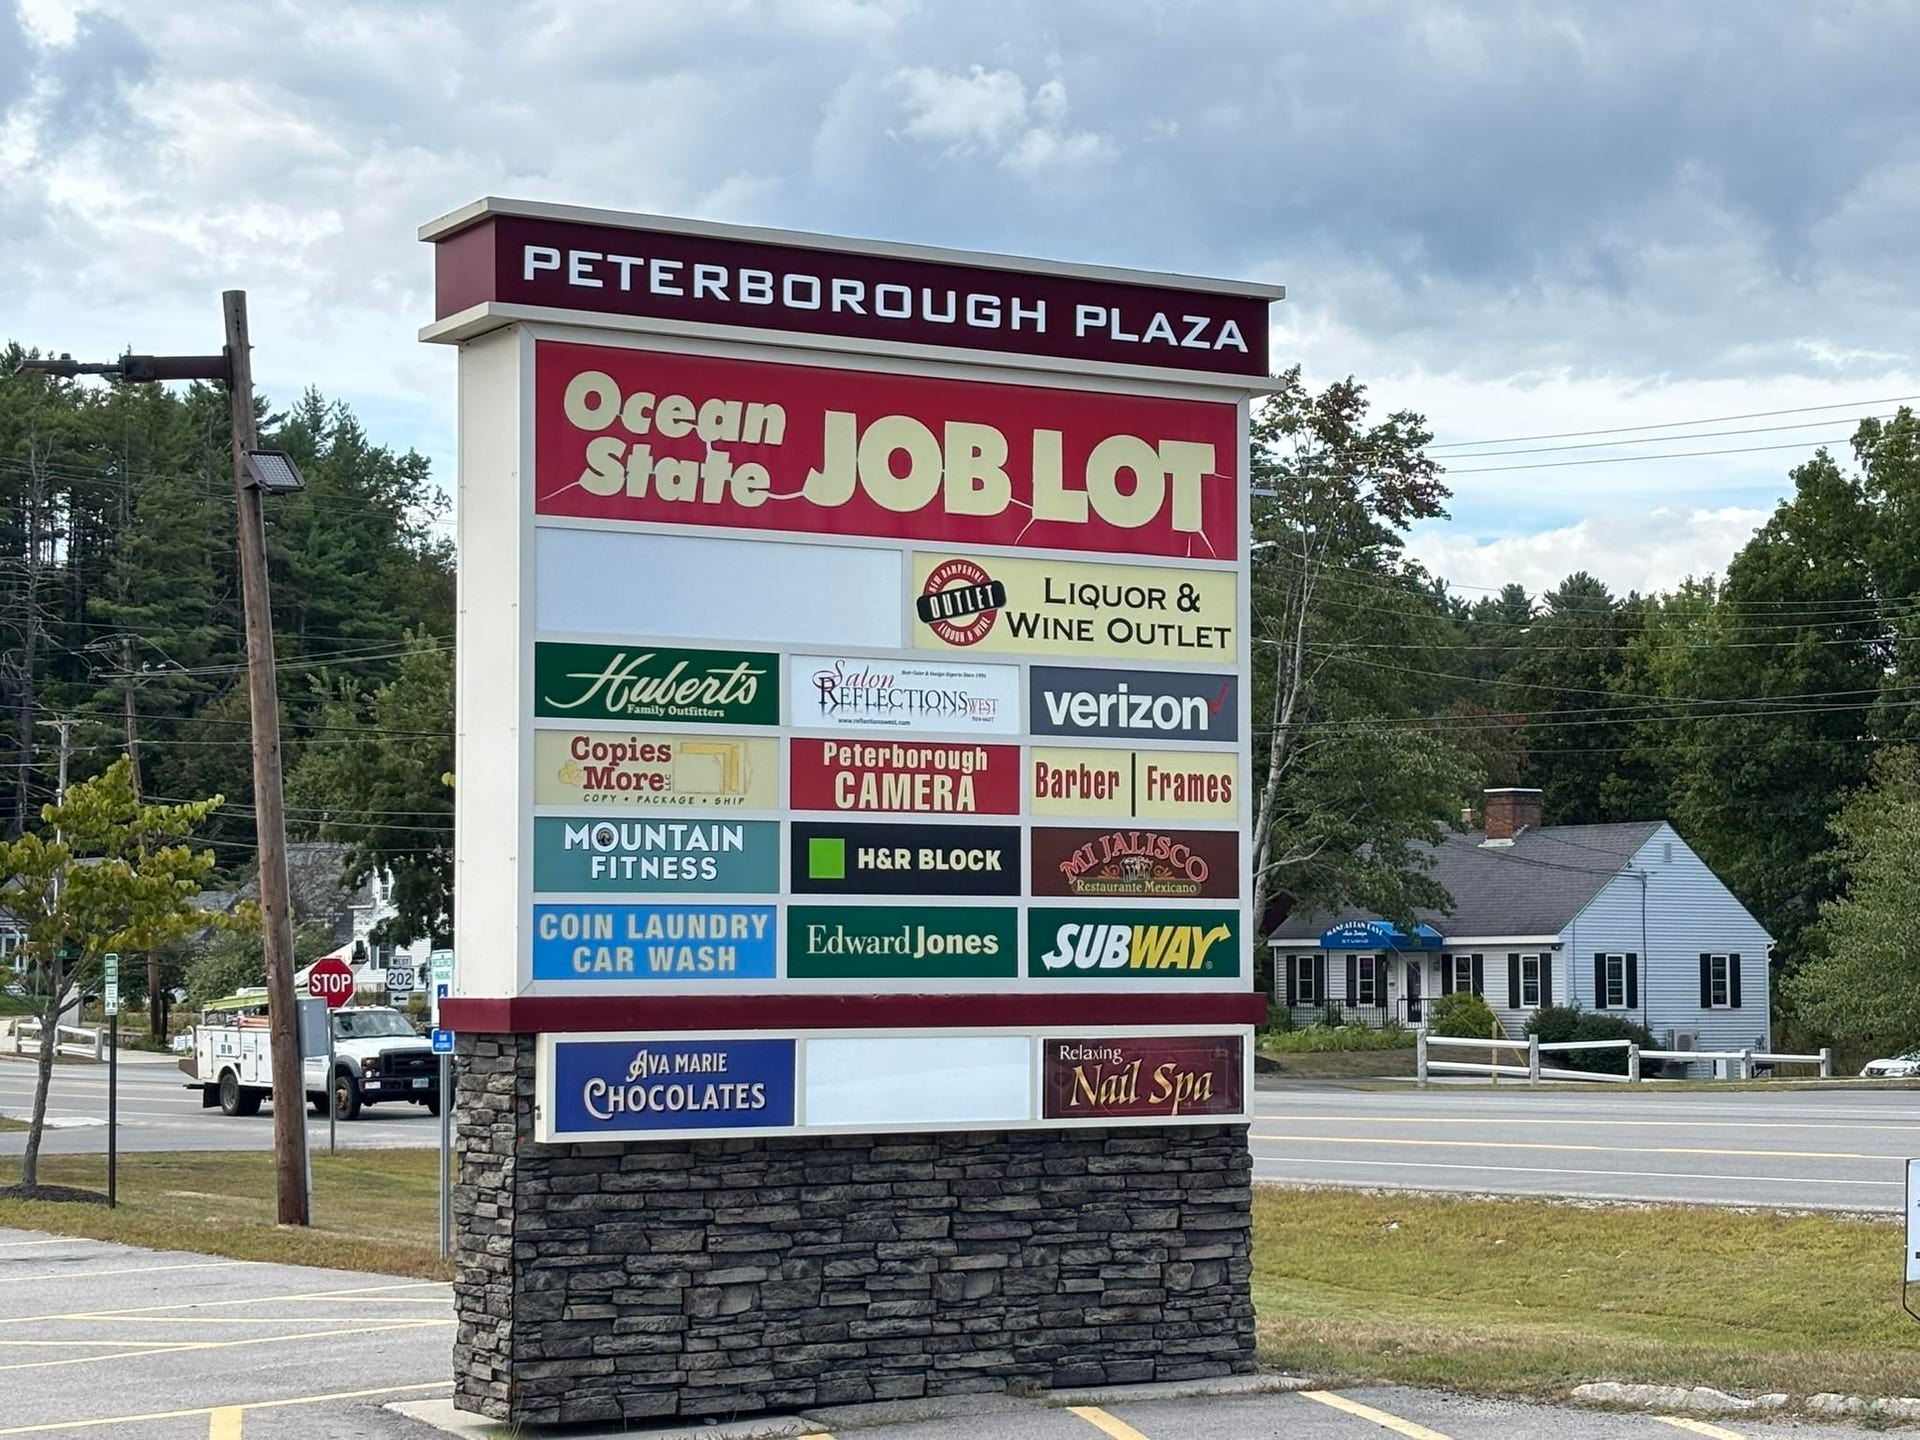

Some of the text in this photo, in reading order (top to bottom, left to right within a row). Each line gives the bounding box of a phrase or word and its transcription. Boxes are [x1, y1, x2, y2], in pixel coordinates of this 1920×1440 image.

[524, 245, 1249, 353] PETERBOROUGH PLAZA
[563, 370, 787, 446] Ocean
[577, 436, 771, 507] State
[801, 410, 1216, 531] JOB LOT
[928, 574, 943, 594] NEW
[1044, 577, 1201, 612] LIQUOR &
[929, 584, 995, 619] OUTLET
[1006, 611, 1232, 649] WINE OUTLET
[544, 652, 768, 713] Hubert's
[812, 659, 895, 692] Salon
[626, 703, 725, 717] Family Outfitters
[818, 676, 968, 711] REFLECTIONS
[1043, 683, 1209, 731] verizon
[570, 735, 672, 767] Copies
[823, 741, 988, 774] Peterborough
[582, 765, 665, 792] More
[835, 771, 976, 812] CAMERA
[1035, 761, 1232, 804] Barber Frames
[583, 793, 746, 806] COPY PACKAGE SHIP
[564, 821, 744, 853] MOUNTAIN
[591, 856, 718, 881] FITNESS
[857, 847, 1003, 871] H&R BLOCK
[1059, 831, 1210, 885] MI JALISCO
[1076, 879, 1197, 894] Restaurante Mexicano
[539, 913, 769, 941] COIN LAUNDRY
[573, 945, 737, 973] CAR WASH
[1041, 922, 1232, 971] SUBWAY
[311, 973, 351, 993] STOP
[389, 972, 412, 985] 202
[626, 1049, 728, 1082] AVA MARIE
[1060, 1045, 1123, 1064] Relaxing
[583, 1077, 767, 1120] CHOCOLATES
[1069, 1058, 1215, 1116] Nail Spa
